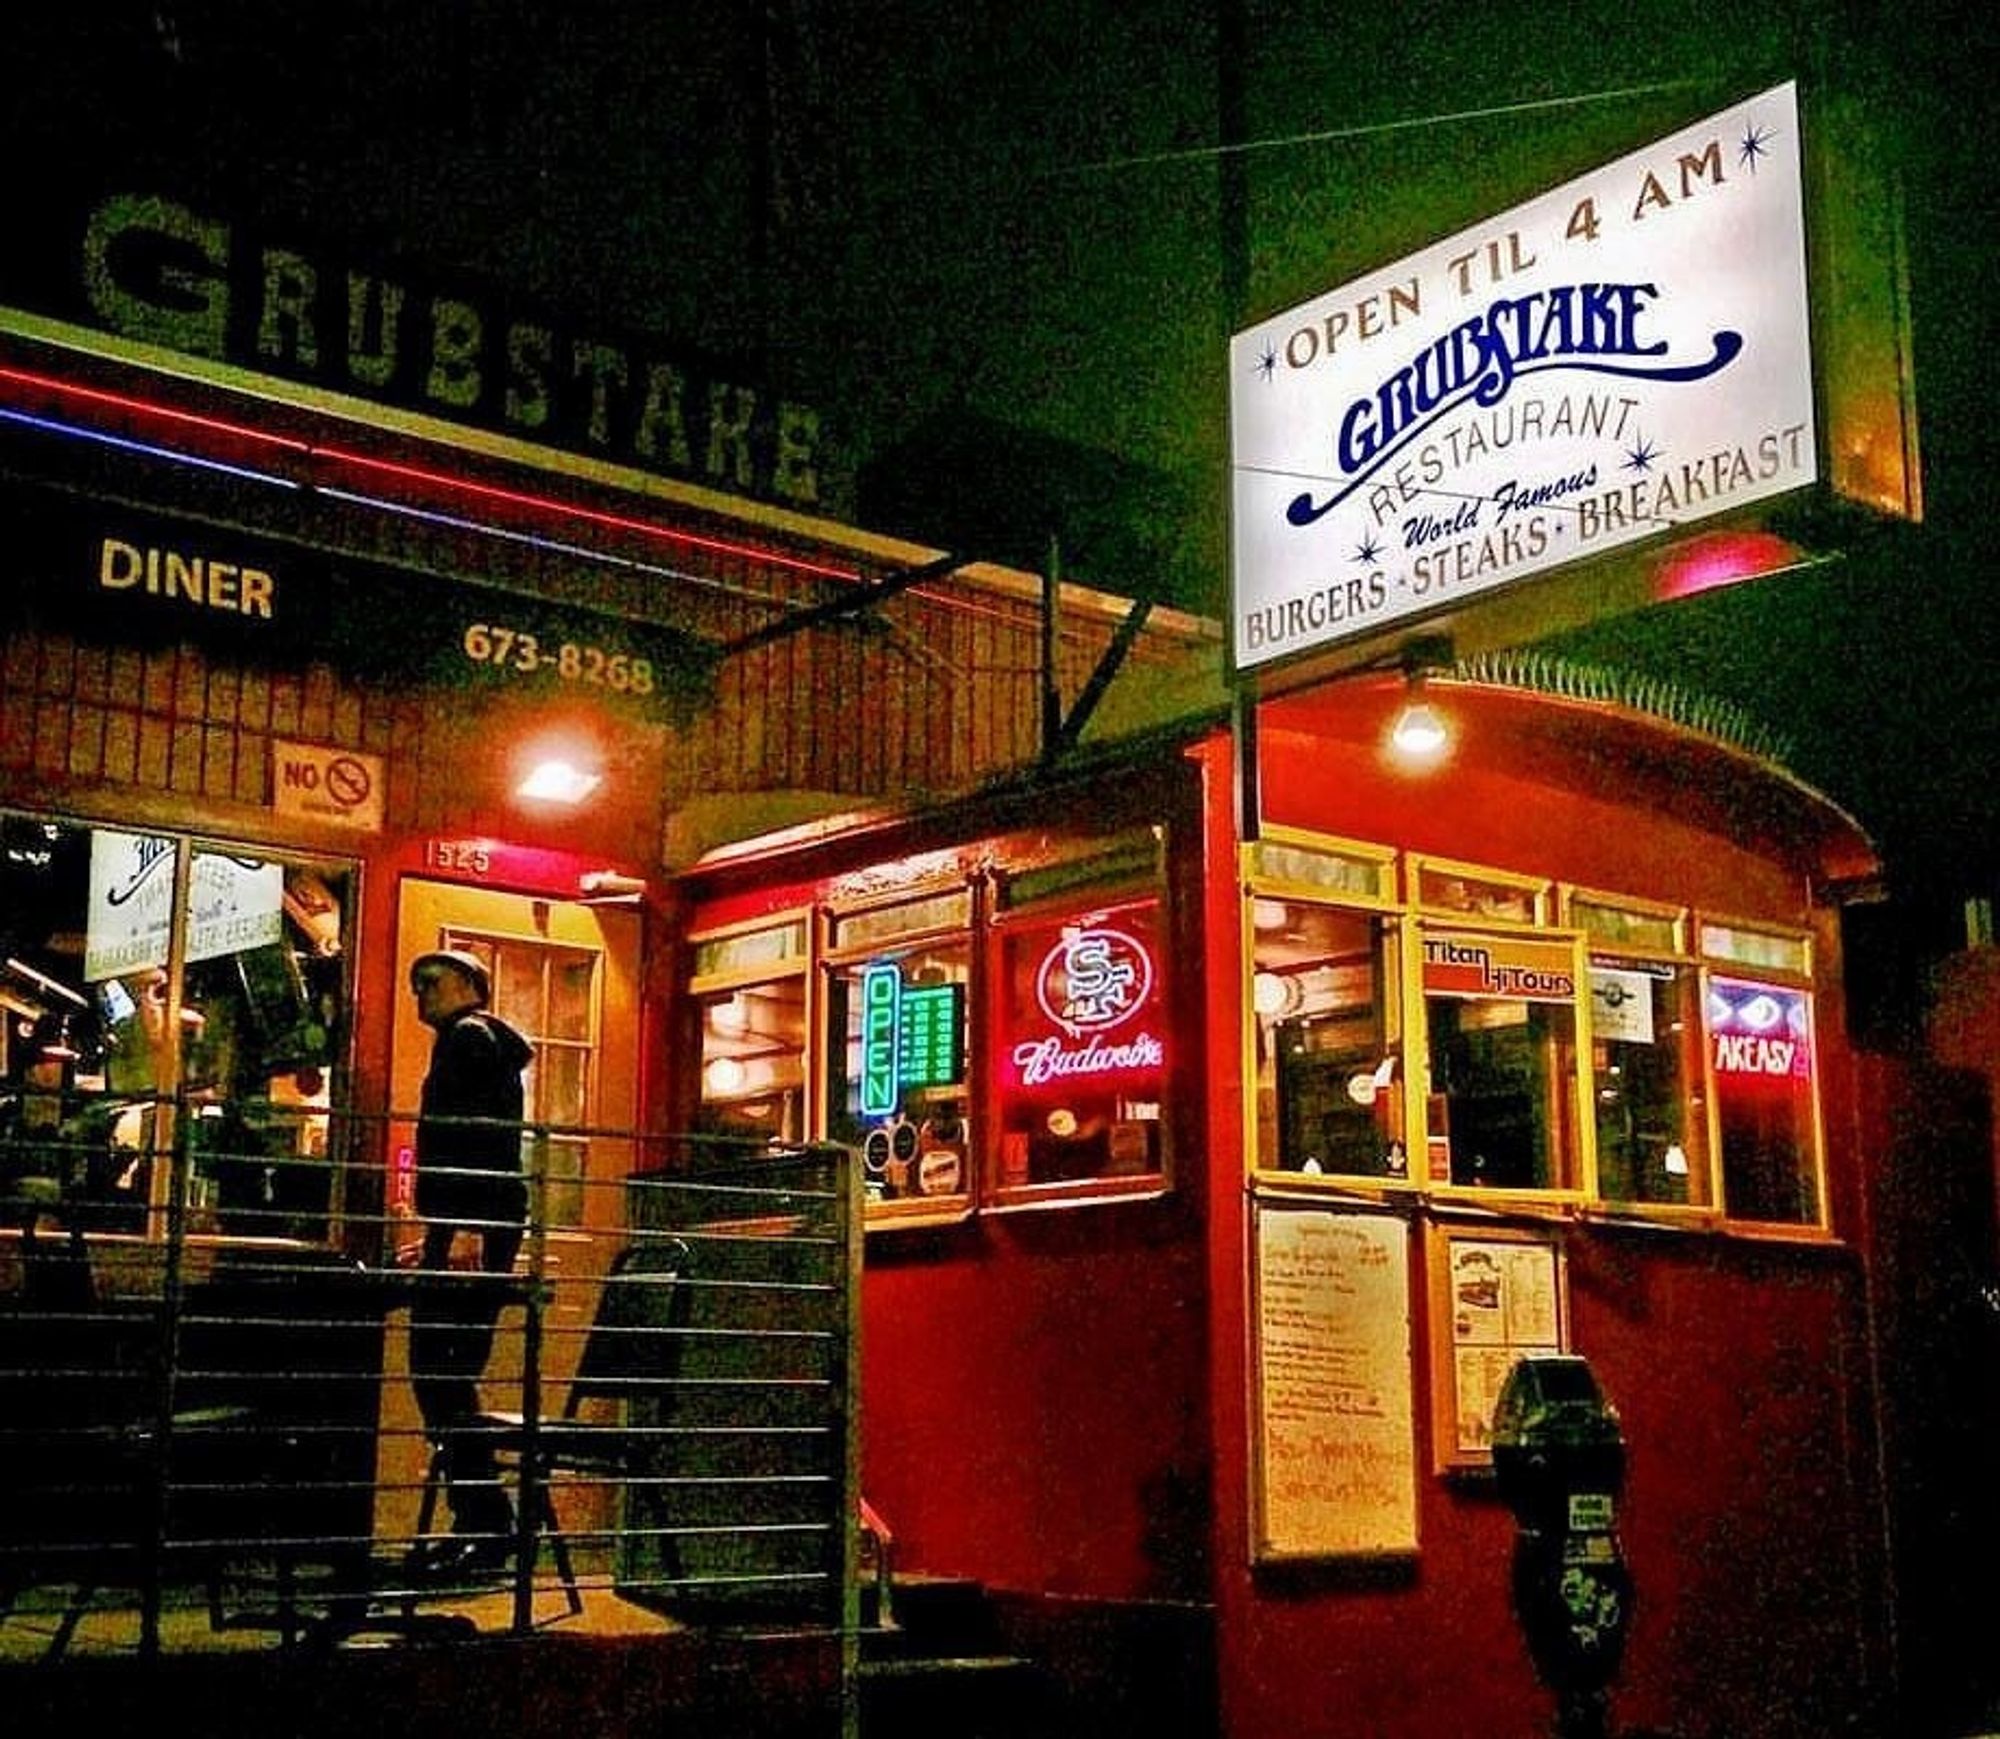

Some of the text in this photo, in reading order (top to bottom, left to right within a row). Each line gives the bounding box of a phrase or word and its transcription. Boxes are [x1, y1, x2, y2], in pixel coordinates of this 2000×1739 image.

[1285, 141, 1727, 369] OPEN TIL 4 AM
[83, 195, 822, 502] GRUBSTAKE
[1337, 282, 1668, 474] GRUBSTAKE
[1369, 395, 1639, 527] RESTAURANT
[1247, 422, 1806, 649] BURGERS STEAKS BREAKFAST
[1402, 463, 1598, 548] World Famous
[101, 538, 273, 619] DINER
[464, 623, 654, 695] 673-8268
[284, 762, 320, 789] NO
[426, 837, 489, 872] 1525
[1423, 940, 1490, 985] Titan
[866, 972, 893, 1109] OPEN
[1713, 1033, 1795, 1076] AKEASY
